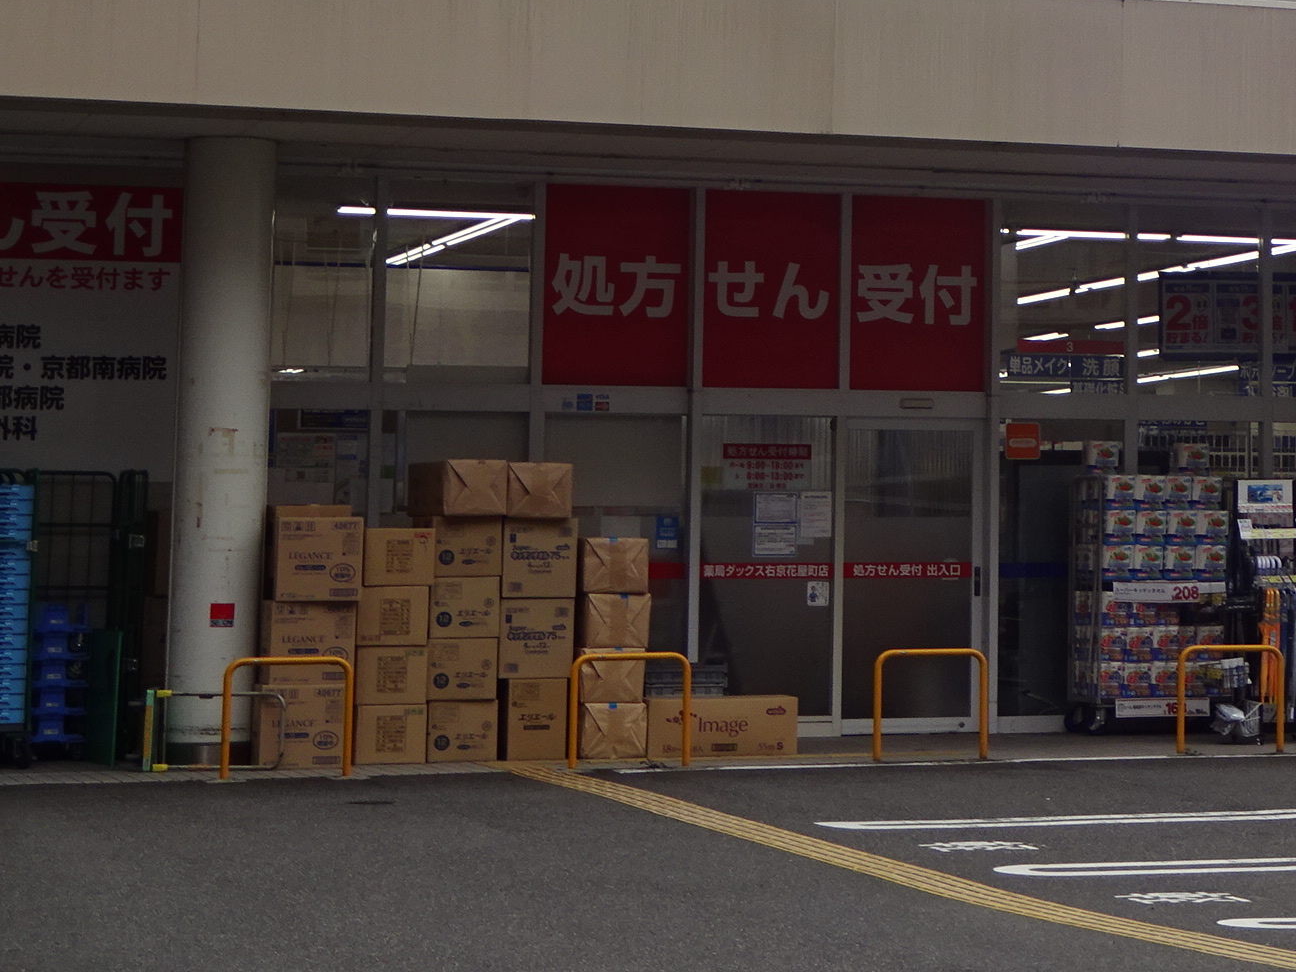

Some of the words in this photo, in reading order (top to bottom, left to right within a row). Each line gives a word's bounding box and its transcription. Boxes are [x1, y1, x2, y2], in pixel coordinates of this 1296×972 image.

[552, 253, 681, 318] 処方
[708, 260, 829, 320] せん
[856, 263, 977, 326] 受付
[1009, 356, 1067, 375] 単品メイク
[853, 564, 923, 577] 処方せん受付
[927, 565, 961, 577] 出入口
[1173, 586, 1199, 600] 208
[1166, 702, 1187, 715] 16
[698, 717, 749, 738] Image
